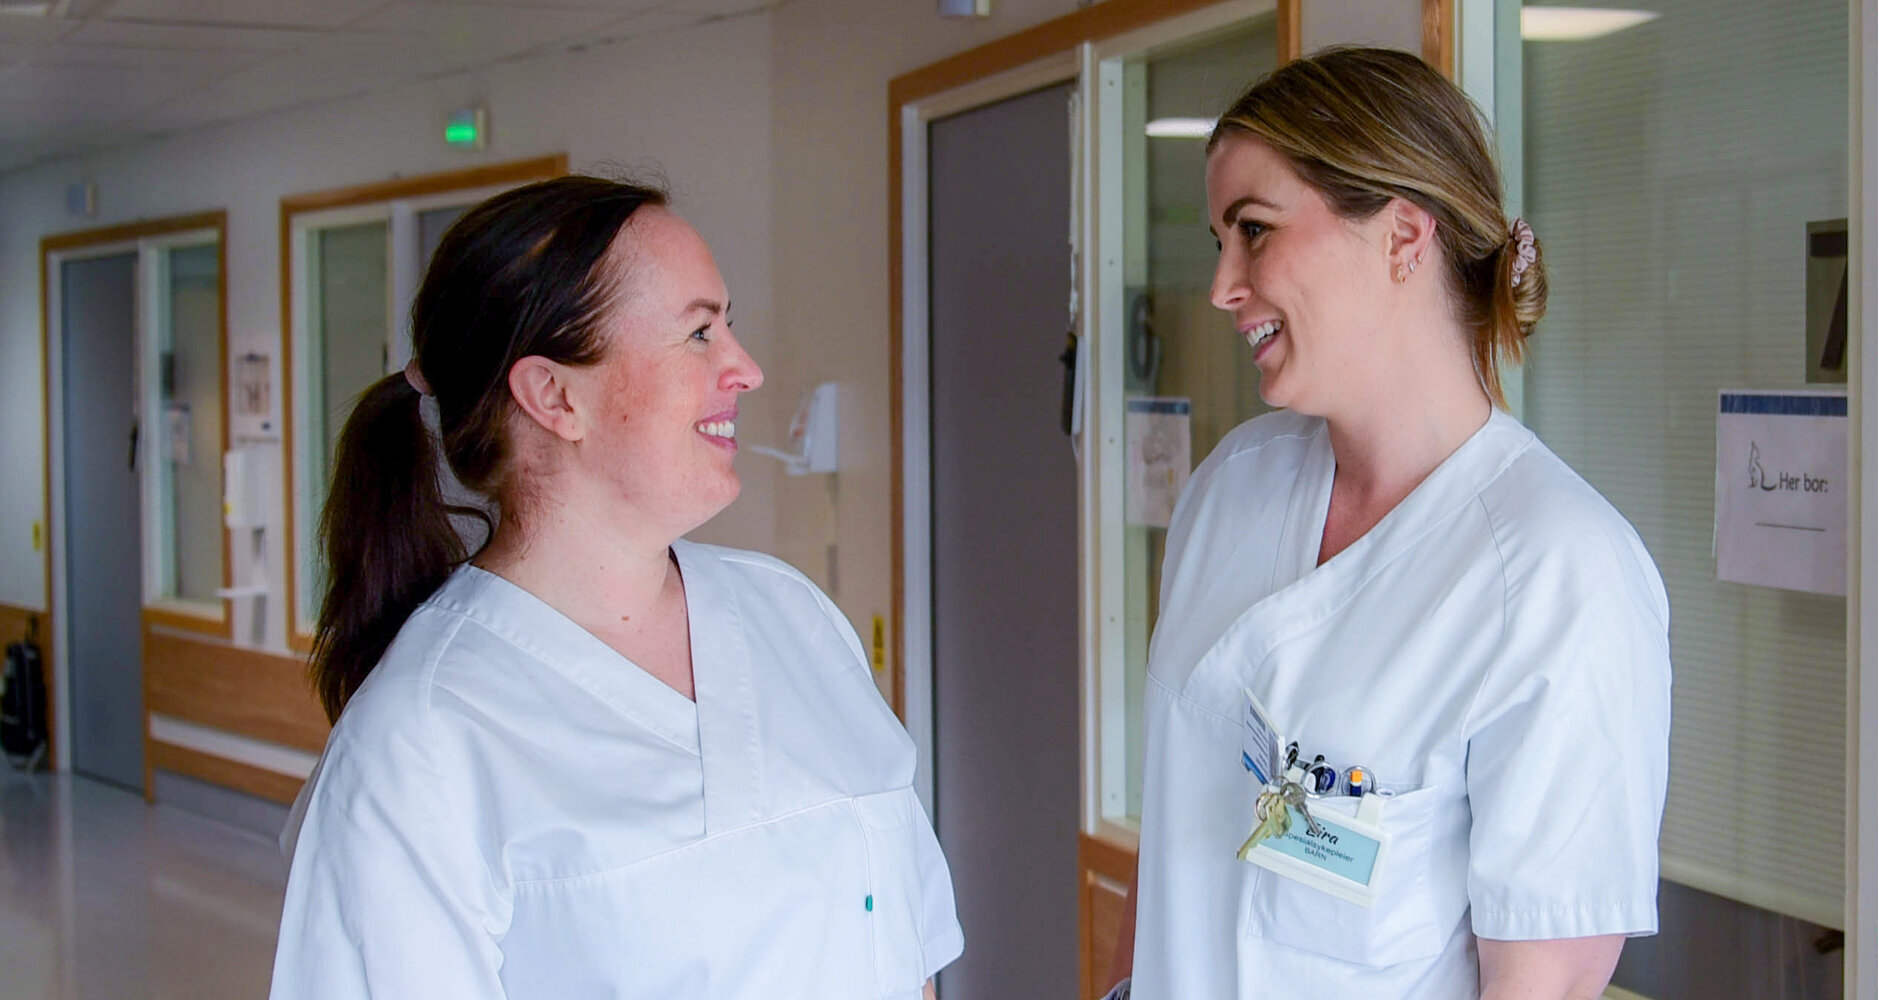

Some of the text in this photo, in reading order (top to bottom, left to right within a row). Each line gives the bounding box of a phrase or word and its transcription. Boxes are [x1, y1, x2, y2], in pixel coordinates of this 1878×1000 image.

[1779, 471, 1829, 493] Her bor:
[1304, 847, 1328, 861] BARN
